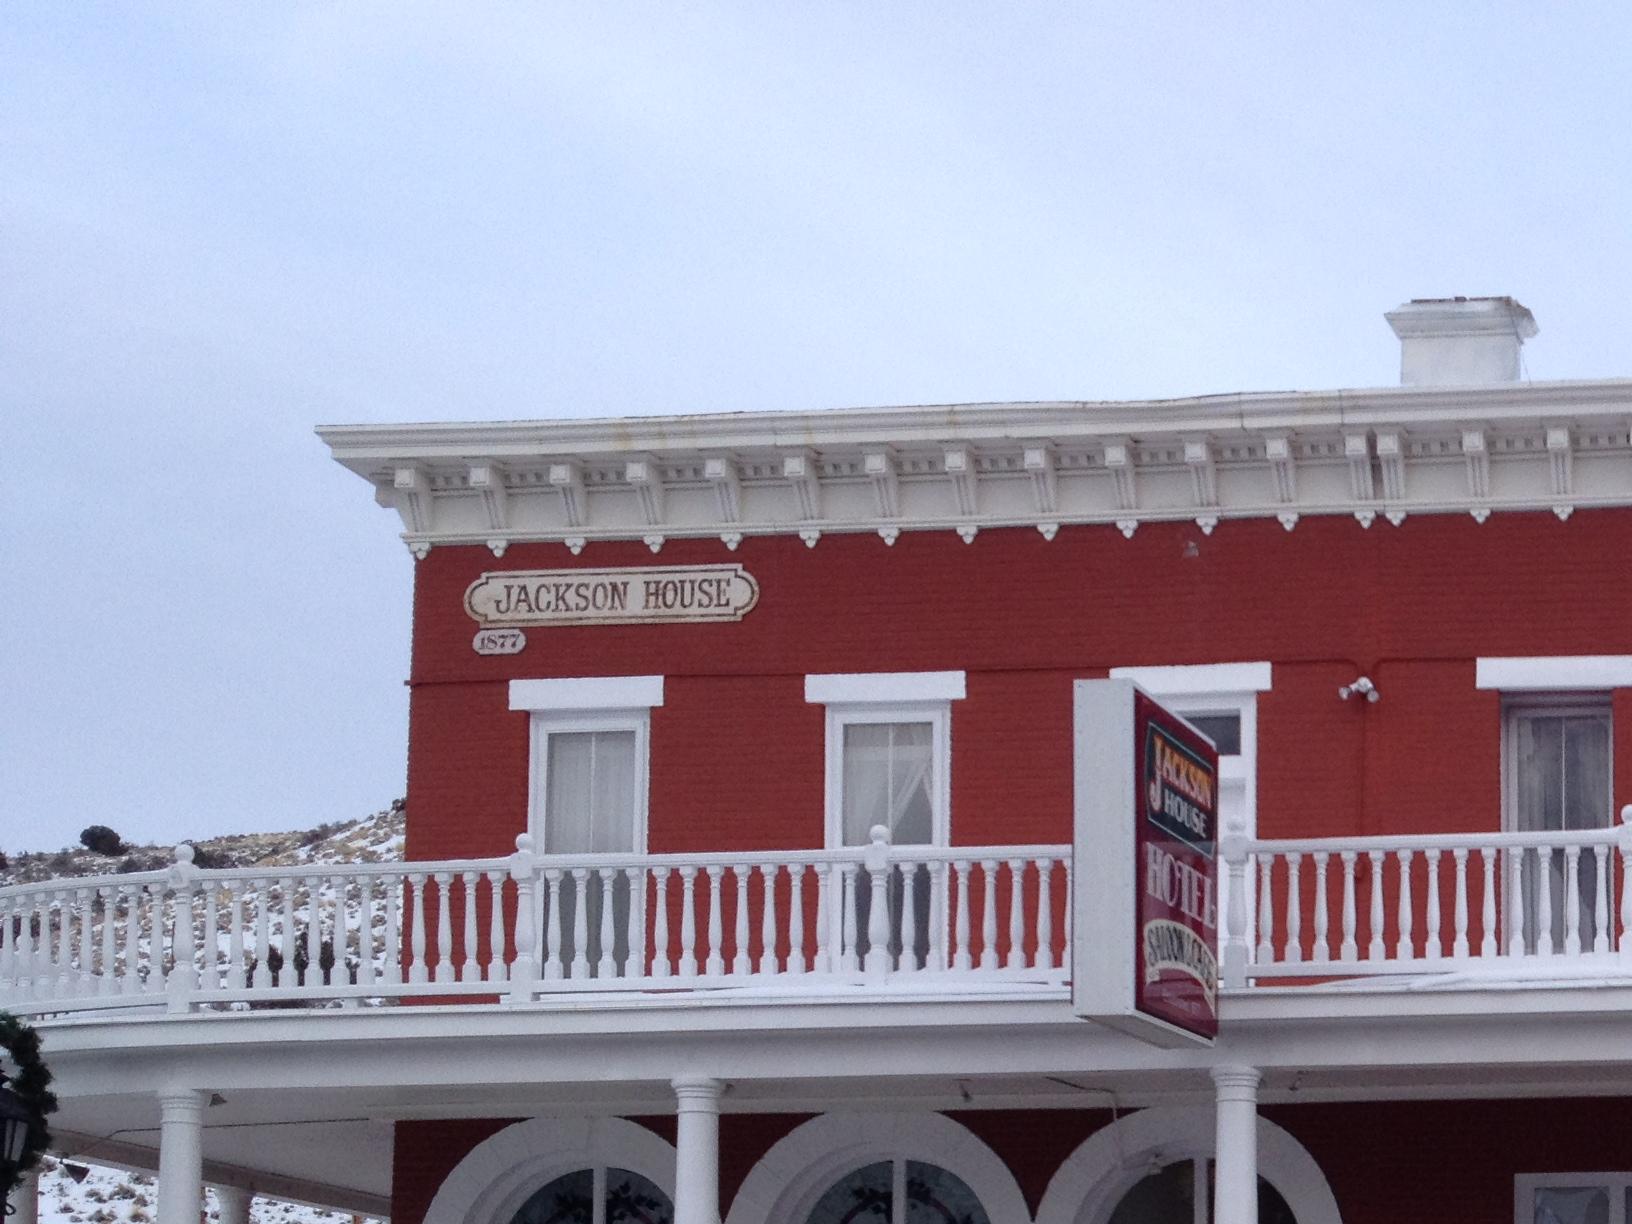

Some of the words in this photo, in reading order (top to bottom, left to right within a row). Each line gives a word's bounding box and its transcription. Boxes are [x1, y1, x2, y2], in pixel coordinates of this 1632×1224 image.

[494, 581, 630, 615] JACKSON
[642, 577, 732, 611] HOUSE
[478, 633, 522, 651] 1877
[1149, 733, 1212, 812] JACKSON
[1163, 788, 1207, 839] HOUSE
[1145, 841, 1216, 930] HOTEL
